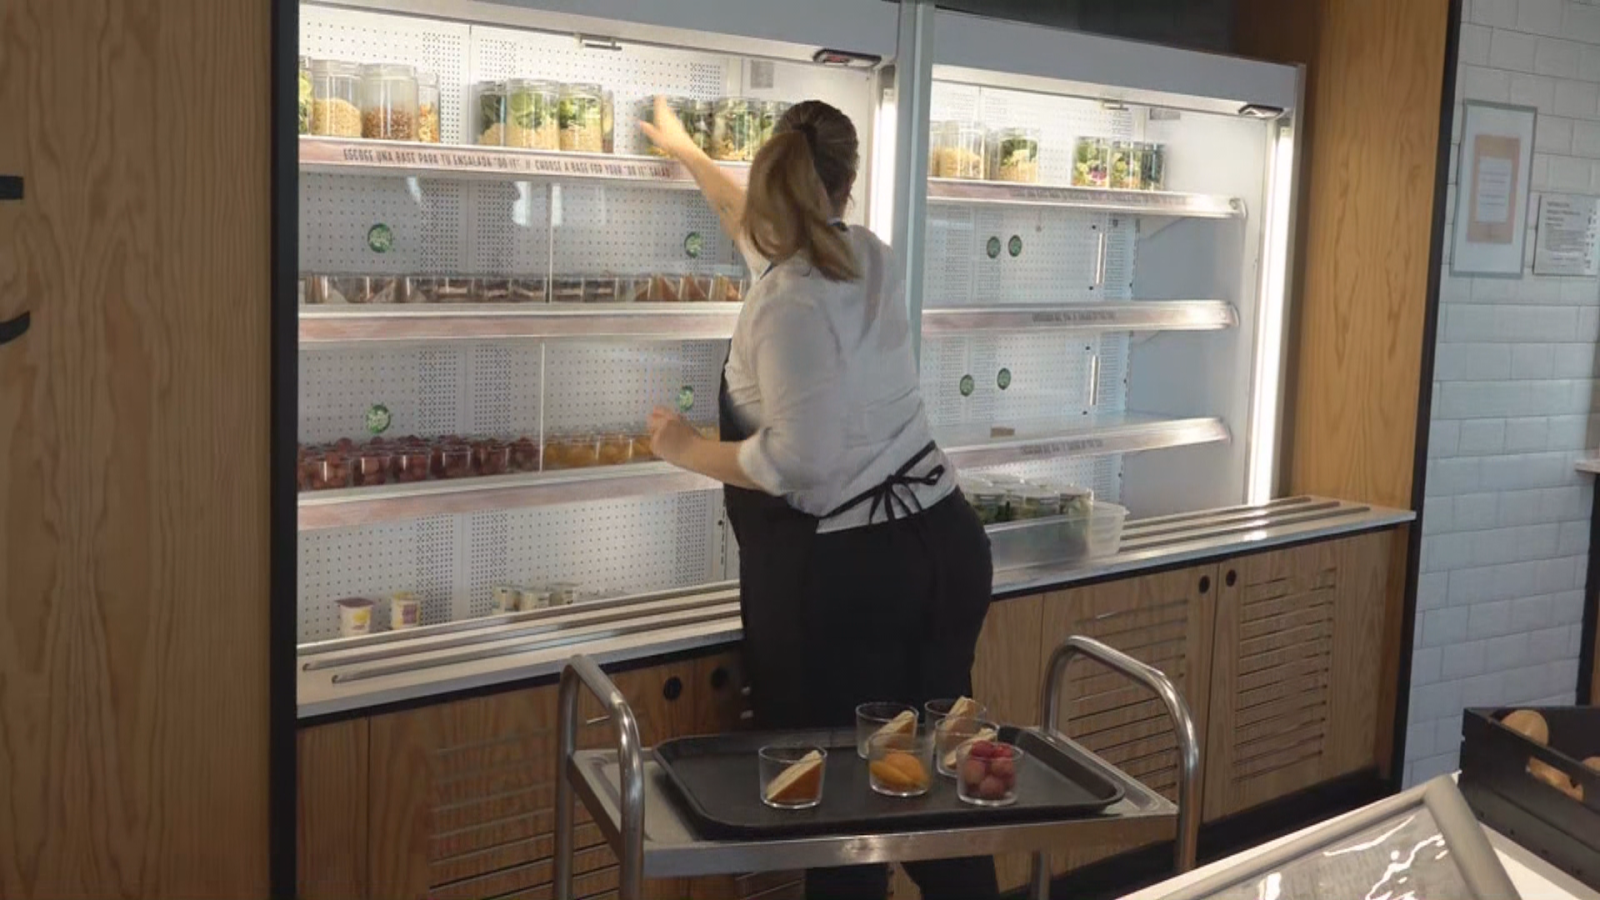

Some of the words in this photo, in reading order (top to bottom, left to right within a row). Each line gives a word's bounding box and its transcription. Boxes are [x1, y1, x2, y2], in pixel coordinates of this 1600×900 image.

[376, 150, 393, 163] UNA
[395, 151, 415, 164] BASE
[418, 152, 439, 165] PARA
[441, 153, 452, 166] TU
[453, 154, 492, 168] ENSALADA
[534, 159, 562, 172] CHOOSE
[564, 161, 570, 172] A
[571, 161, 589, 174] BASE
[590, 162, 603, 175] FOR
[604, 163, 622, 176] YOUR
[649, 166, 671, 178] SALAD
